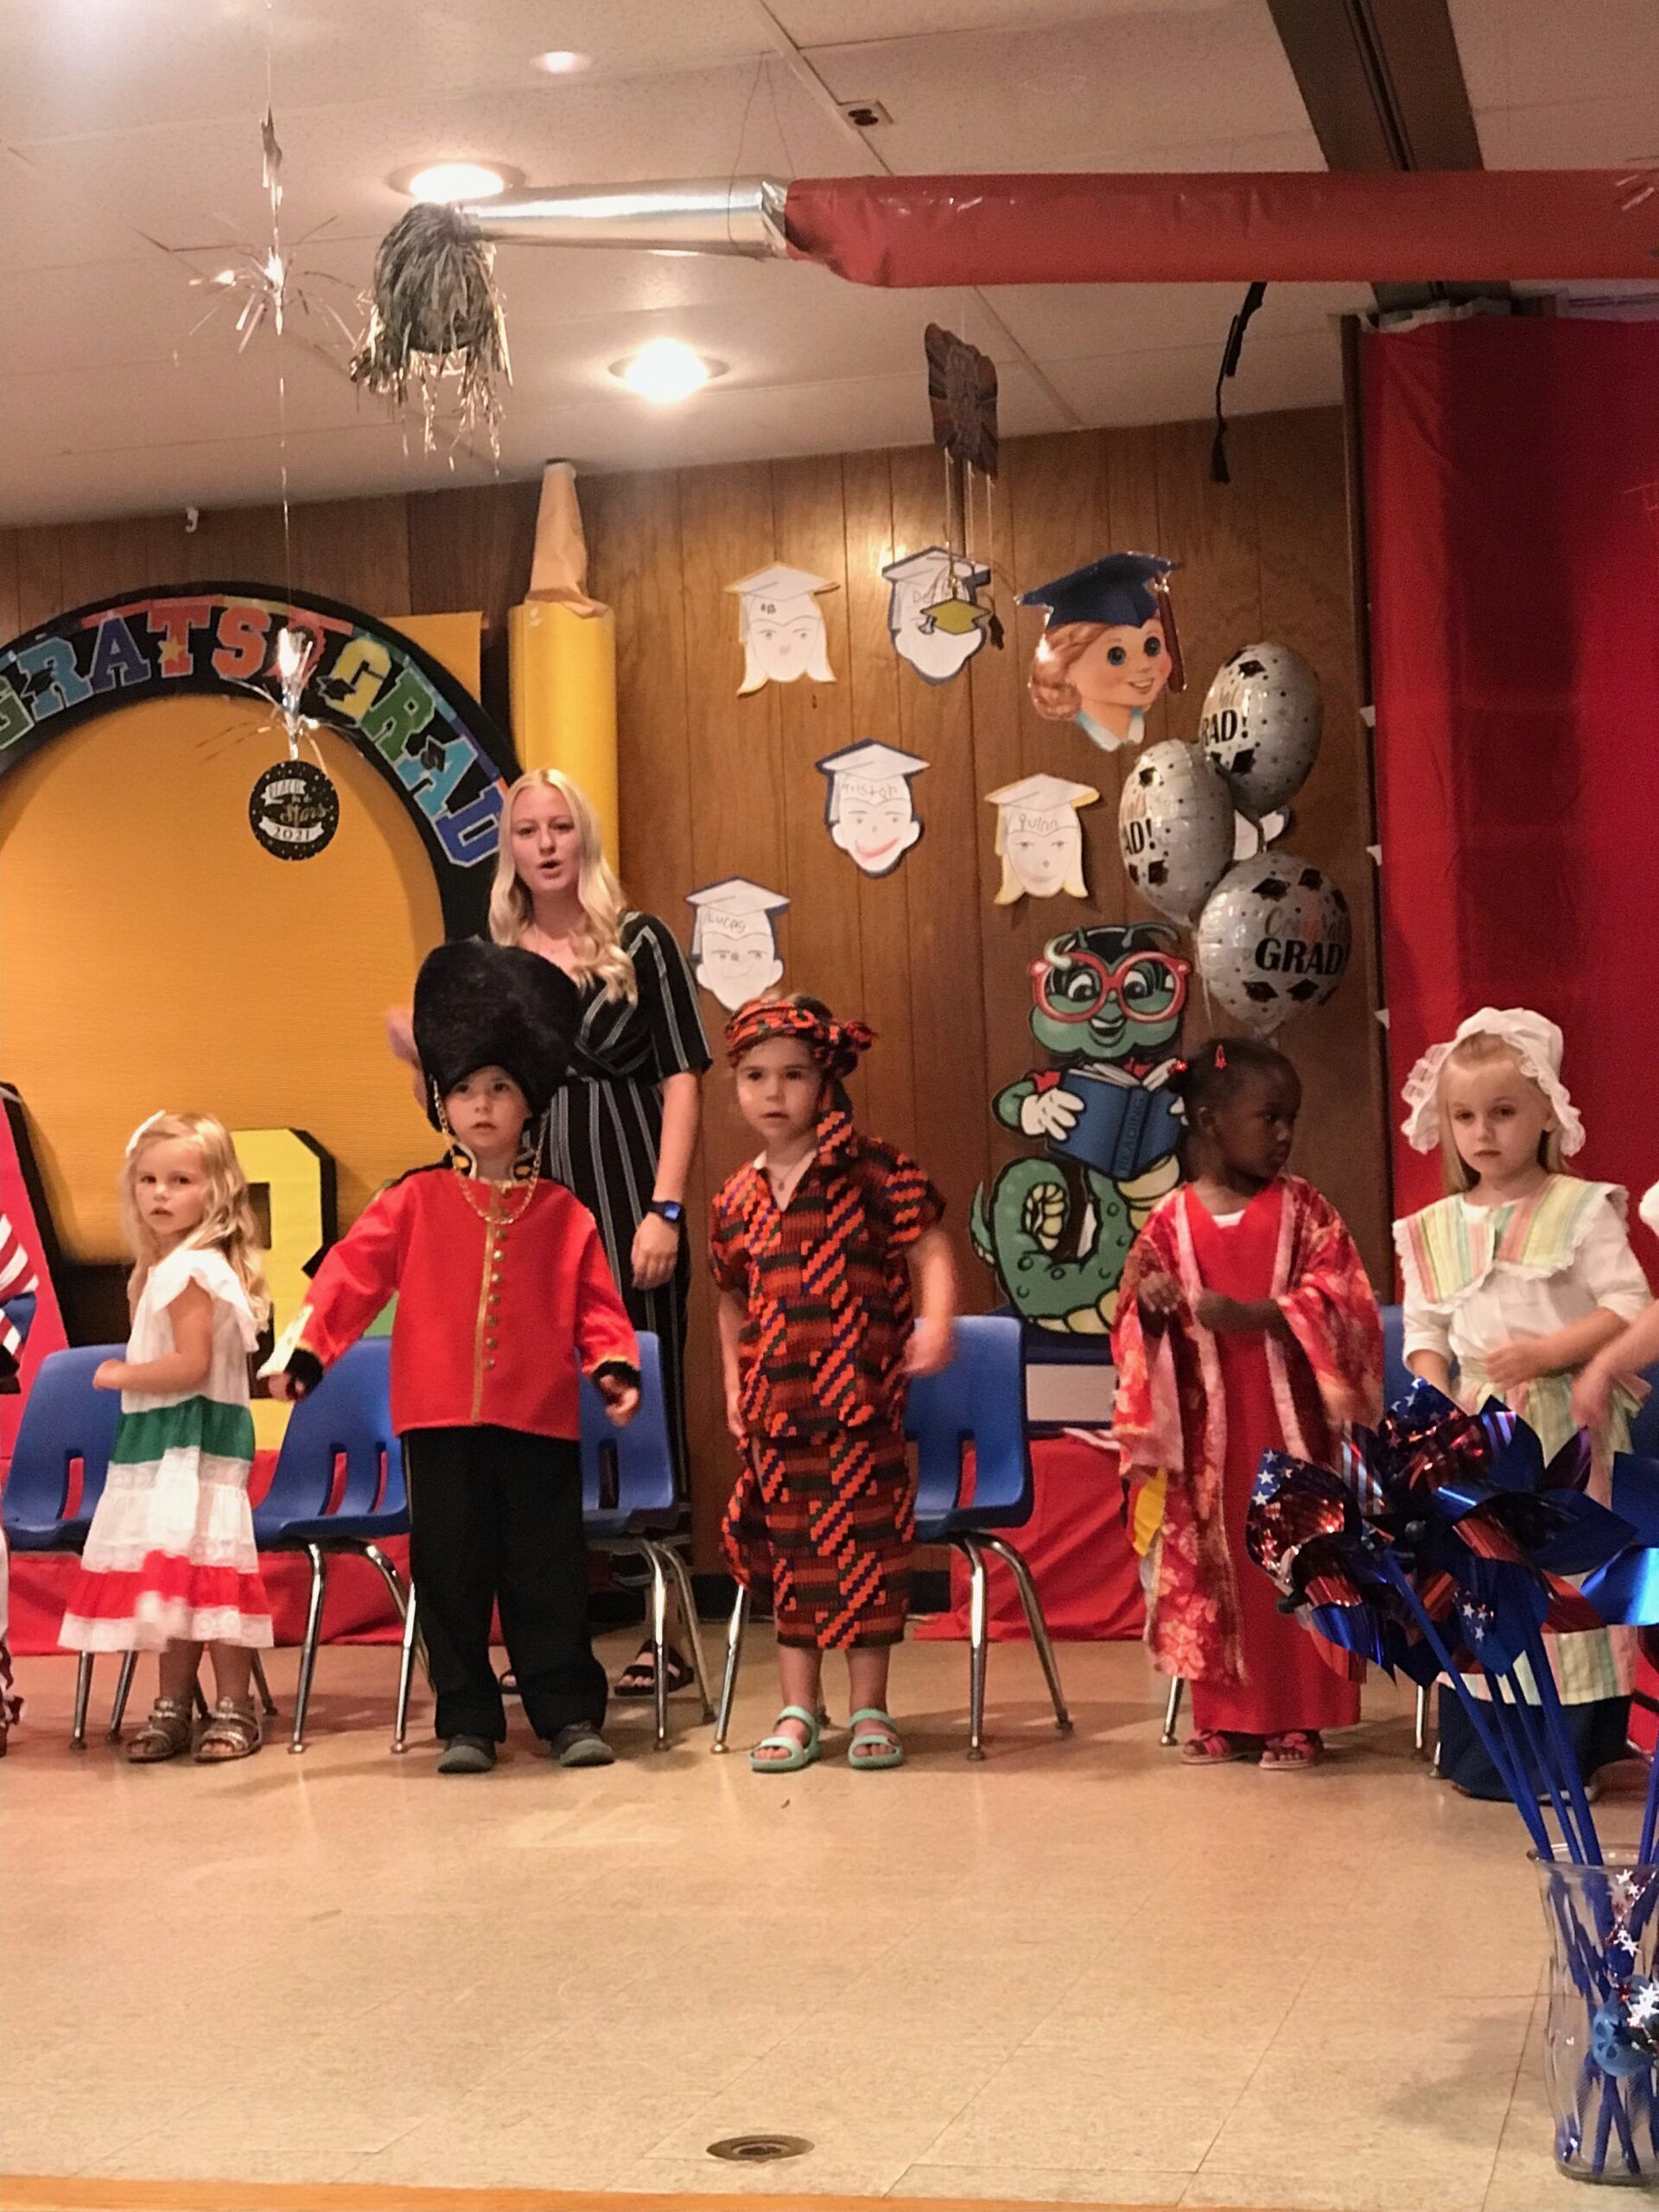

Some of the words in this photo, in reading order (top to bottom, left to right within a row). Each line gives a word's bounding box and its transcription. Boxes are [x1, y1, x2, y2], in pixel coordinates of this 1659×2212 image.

[1202, 709, 1249, 747] RAD!
[317, 637, 505, 867] GRAD
[274, 827, 310, 840] 2021
[1122, 817, 1155, 856] AD!
